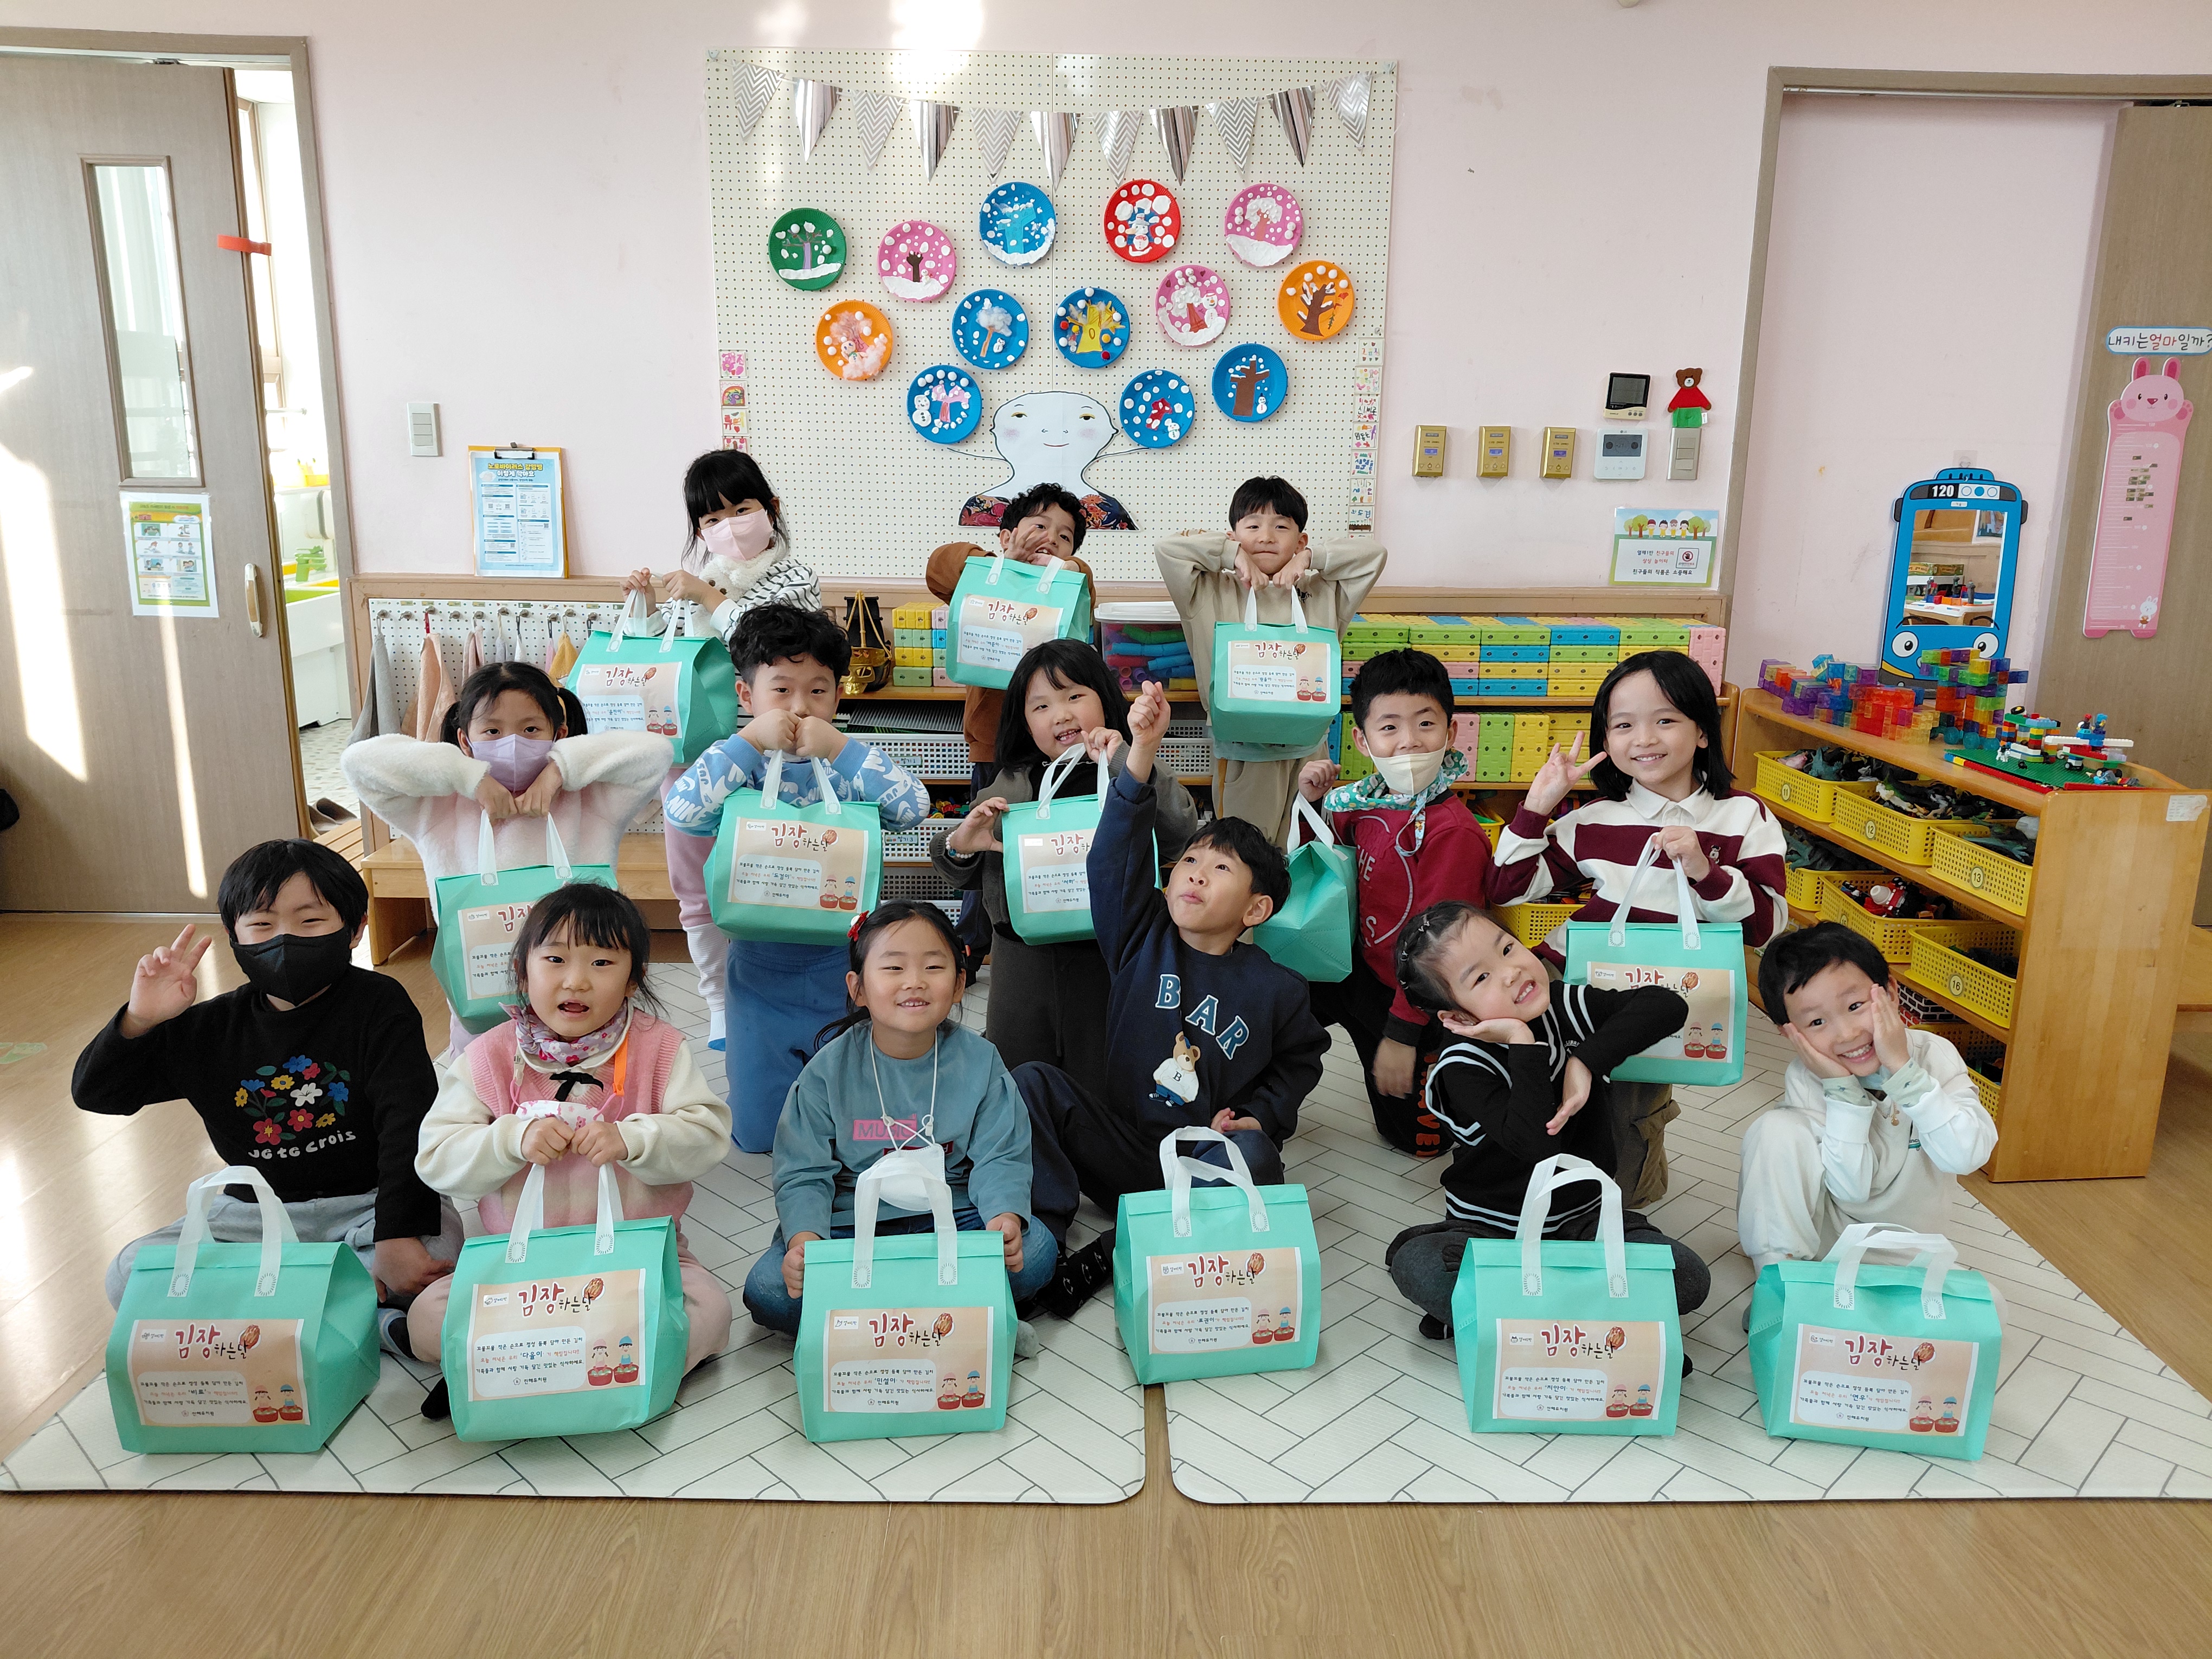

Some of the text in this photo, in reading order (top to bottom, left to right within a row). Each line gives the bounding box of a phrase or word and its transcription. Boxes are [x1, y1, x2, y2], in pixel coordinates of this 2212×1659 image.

[1932, 485, 1954, 497] 120
[988, 601, 1014, 621] 김장
[1255, 642, 1282, 658] 김장
[606, 666, 633, 686] 김장
[697, 761, 709, 785] JUS
[880, 788, 898, 805] JUS
[667, 795, 707, 824] NIKE
[771, 824, 807, 848] 김장
[1867, 825, 1874, 834] 12
[1051, 833, 1084, 855] 김장
[1357, 844, 1375, 882] HE
[1973, 873, 1981, 882] 13
[1952, 980, 1961, 991] 16
[1155, 974, 1249, 1060] BAR
[1173, 1071, 1182, 1082] B
[277, 1147, 300, 1158] te
[1188, 1255, 1229, 1288] 김장
[519, 1283, 564, 1317] 김장
[175, 1324, 221, 1359] 김장
[869, 1313, 914, 1347] 김장
[1541, 1324, 1586, 1356] 김장
[1844, 1335, 1893, 1367] 김장
